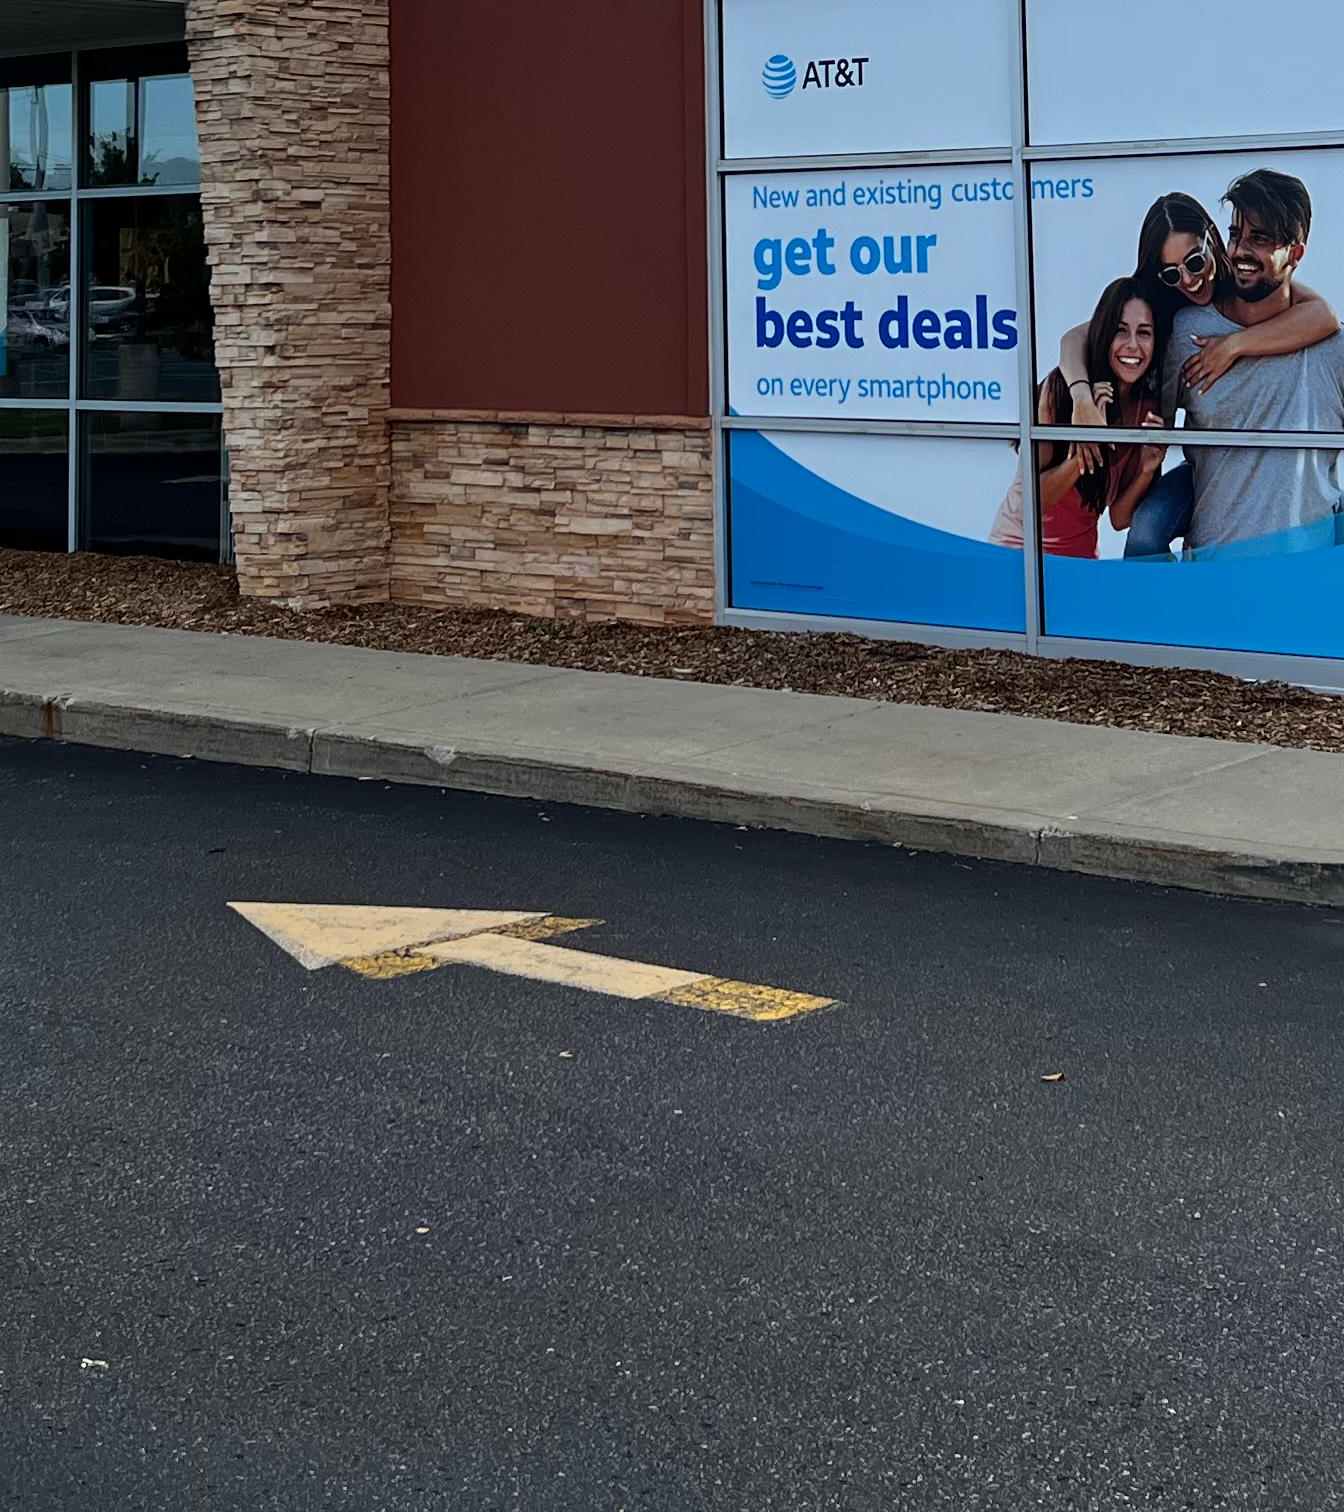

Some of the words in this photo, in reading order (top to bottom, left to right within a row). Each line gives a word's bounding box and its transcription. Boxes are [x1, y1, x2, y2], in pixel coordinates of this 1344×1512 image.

[802, 57, 869, 90] AT&T
[752, 185, 800, 208] New
[805, 181, 847, 207] and
[853, 179, 942, 210] existing
[753, 228, 837, 290] get
[849, 234, 938, 275] our
[756, 296, 864, 349] best
[878, 294, 1018, 350] deals
[757, 377, 783, 396] on
[790, 377, 851, 404] every
[857, 373, 1002, 405] smartphone
